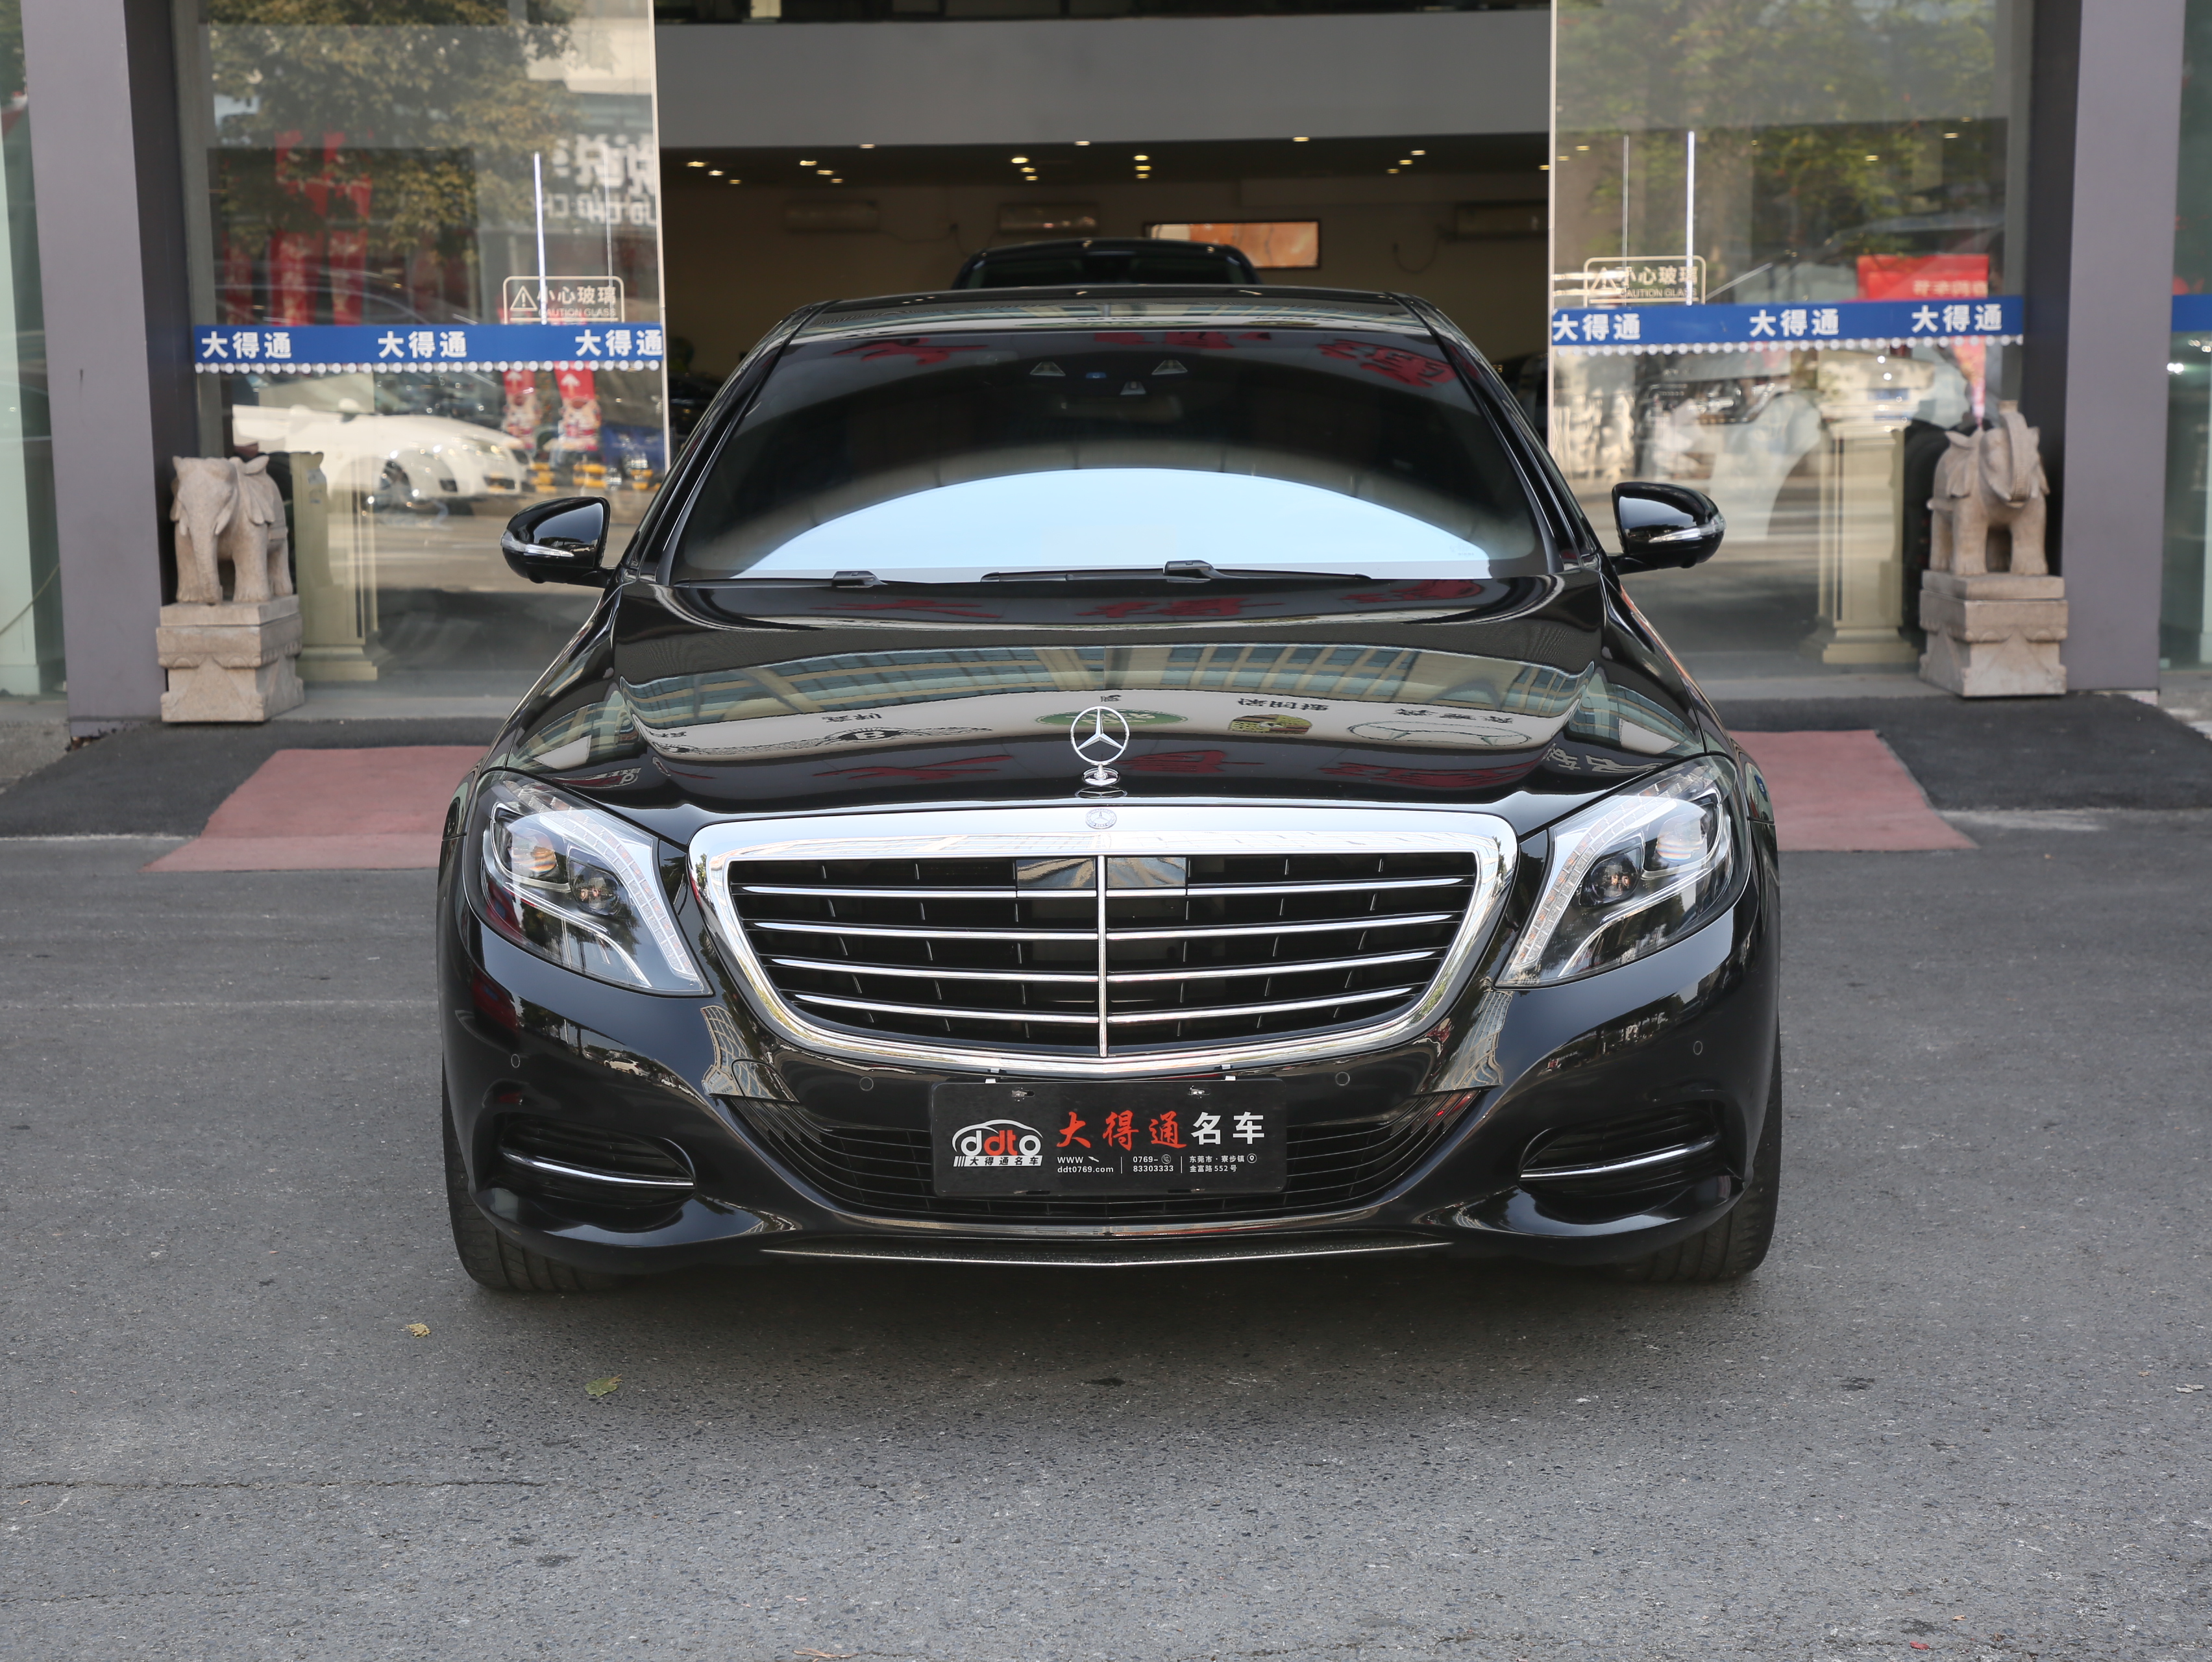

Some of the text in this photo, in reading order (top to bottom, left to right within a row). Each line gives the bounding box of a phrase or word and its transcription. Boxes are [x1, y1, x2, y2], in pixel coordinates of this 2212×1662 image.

[537, 285, 617, 305] 小心玻璃
[584, 308, 617, 317] GLASS
[1749, 308, 1839, 337] 大得通
[1911, 303, 2002, 333] 大得通
[1553, 313, 1641, 341] 大得通
[201, 331, 292, 359] 大得通
[377, 330, 467, 358] 大得通
[575, 329, 663, 356] 大得通
[1057, 1110, 1265, 1150] 大得通名车
[970, 1156, 1039, 1166] 大得通名车
